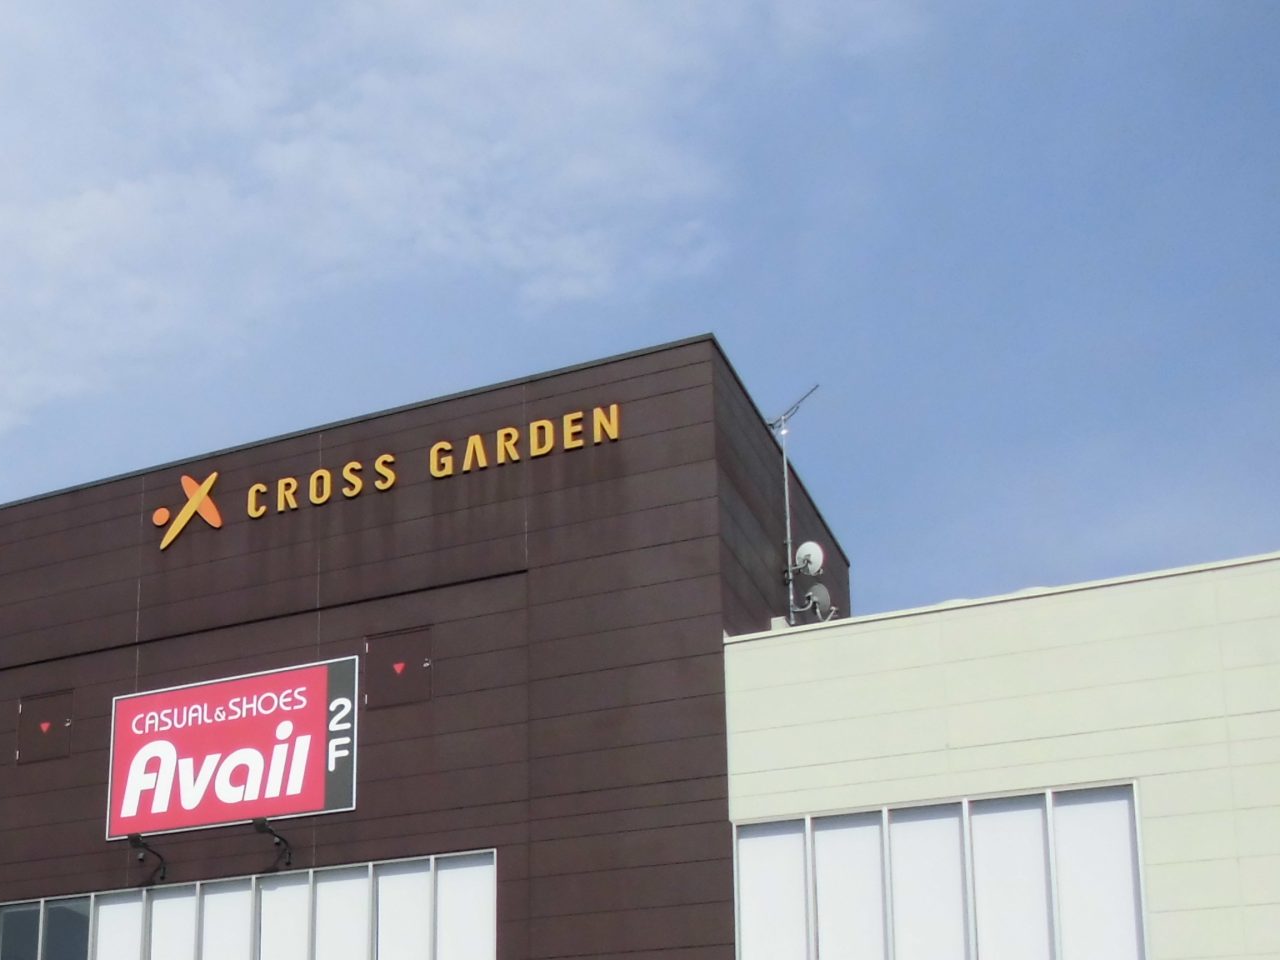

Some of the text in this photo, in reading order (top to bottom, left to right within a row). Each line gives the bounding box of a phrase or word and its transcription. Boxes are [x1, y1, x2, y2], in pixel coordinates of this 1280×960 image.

[247, 403, 621, 519] CROSS GARDEN
[120, 720, 312, 818] Avail
